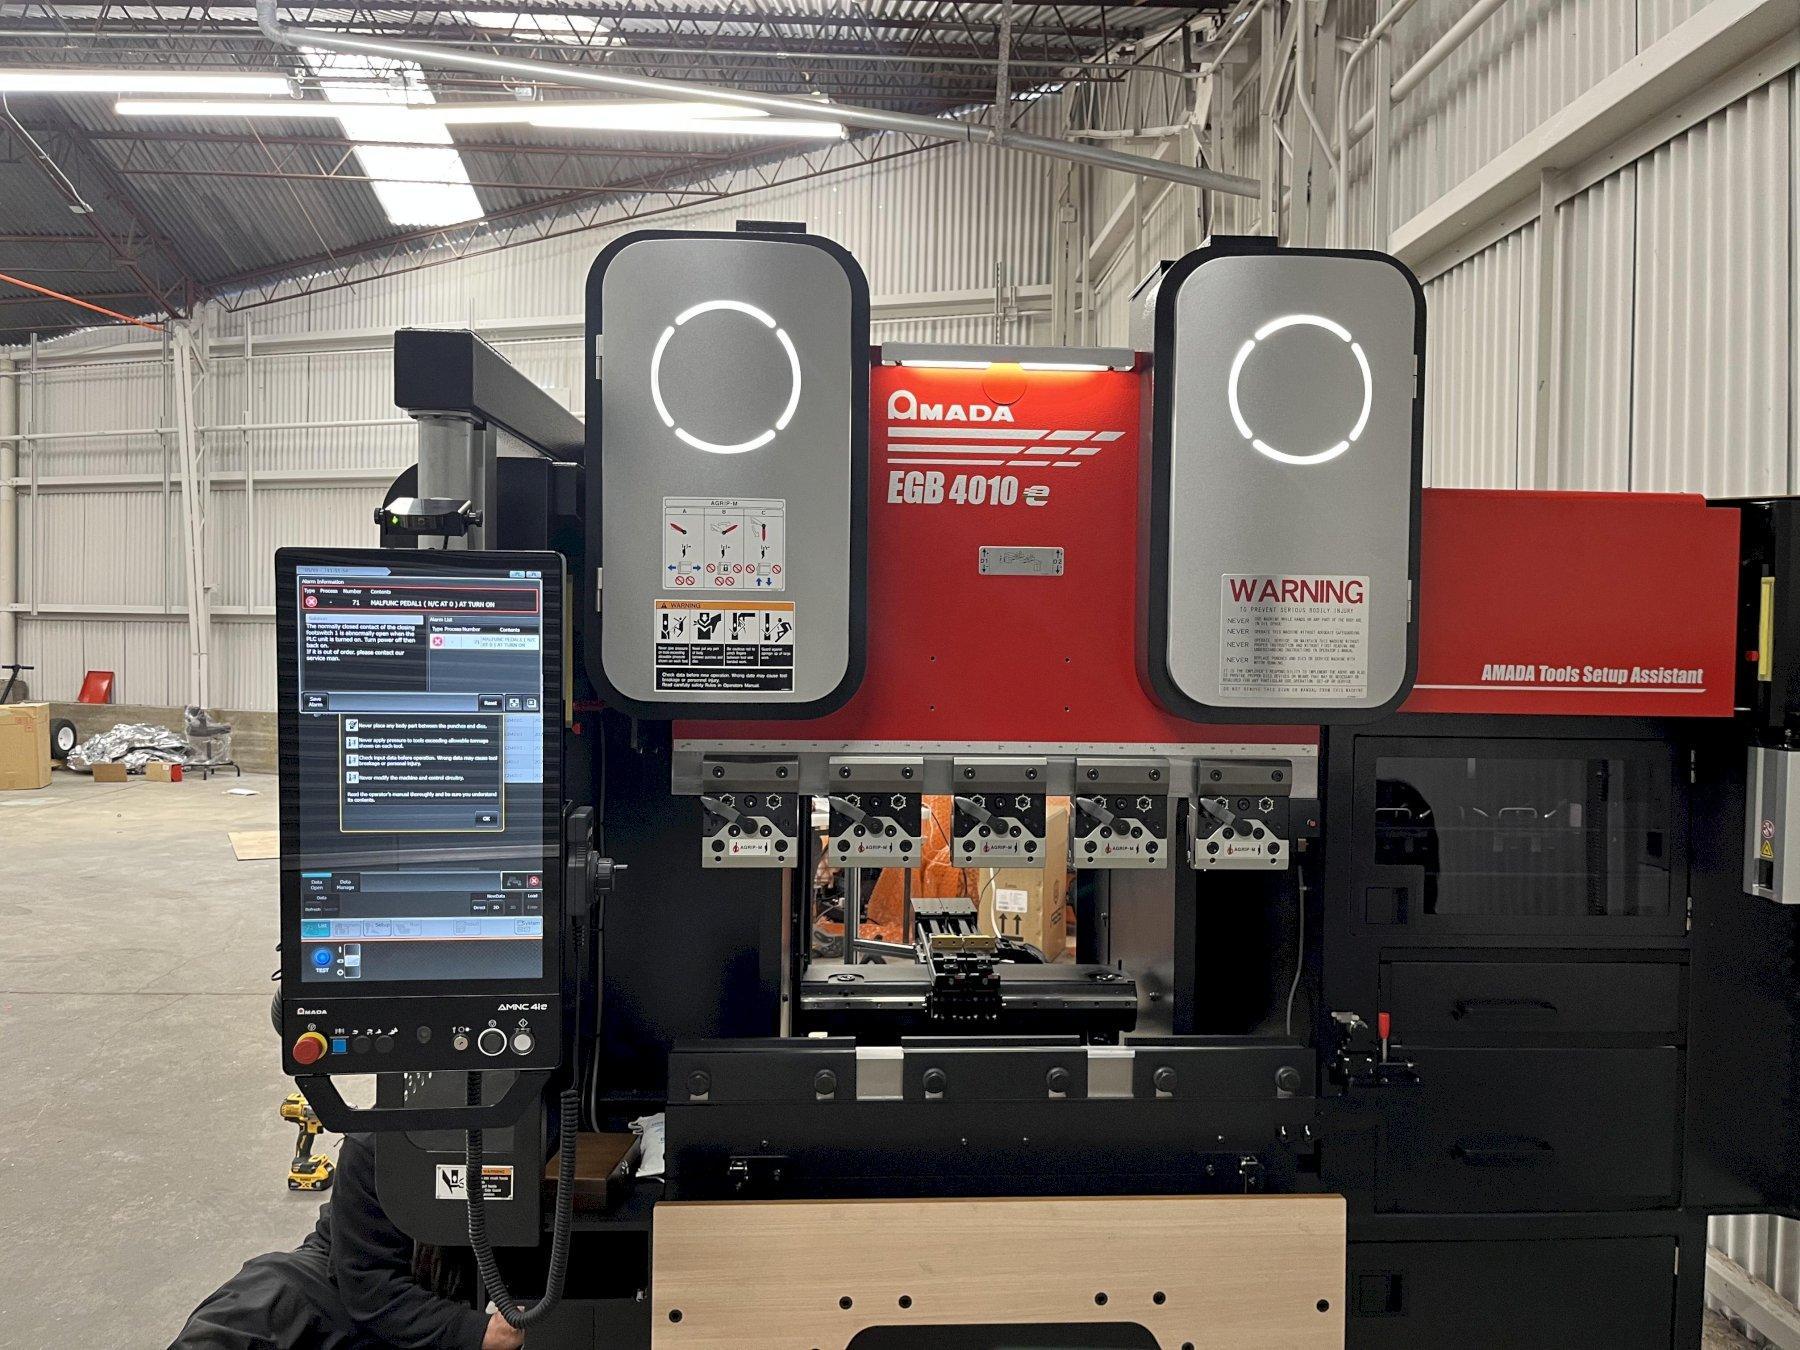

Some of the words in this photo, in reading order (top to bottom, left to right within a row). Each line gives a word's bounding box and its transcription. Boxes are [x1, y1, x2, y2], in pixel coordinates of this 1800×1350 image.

[888, 389, 1015, 422] AMADA
[887, 470, 945, 505] EGB
[948, 474, 1019, 506] 4010
[1229, 578, 1364, 604] WARNING
[1481, 663, 1535, 681] AMADA
[1539, 665, 1580, 682] Tools
[1583, 665, 1628, 684] Setup
[1630, 667, 1704, 684] Assistant
[297, 1007, 327, 1015] AMADA
[497, 1003, 529, 1011] AMNC
